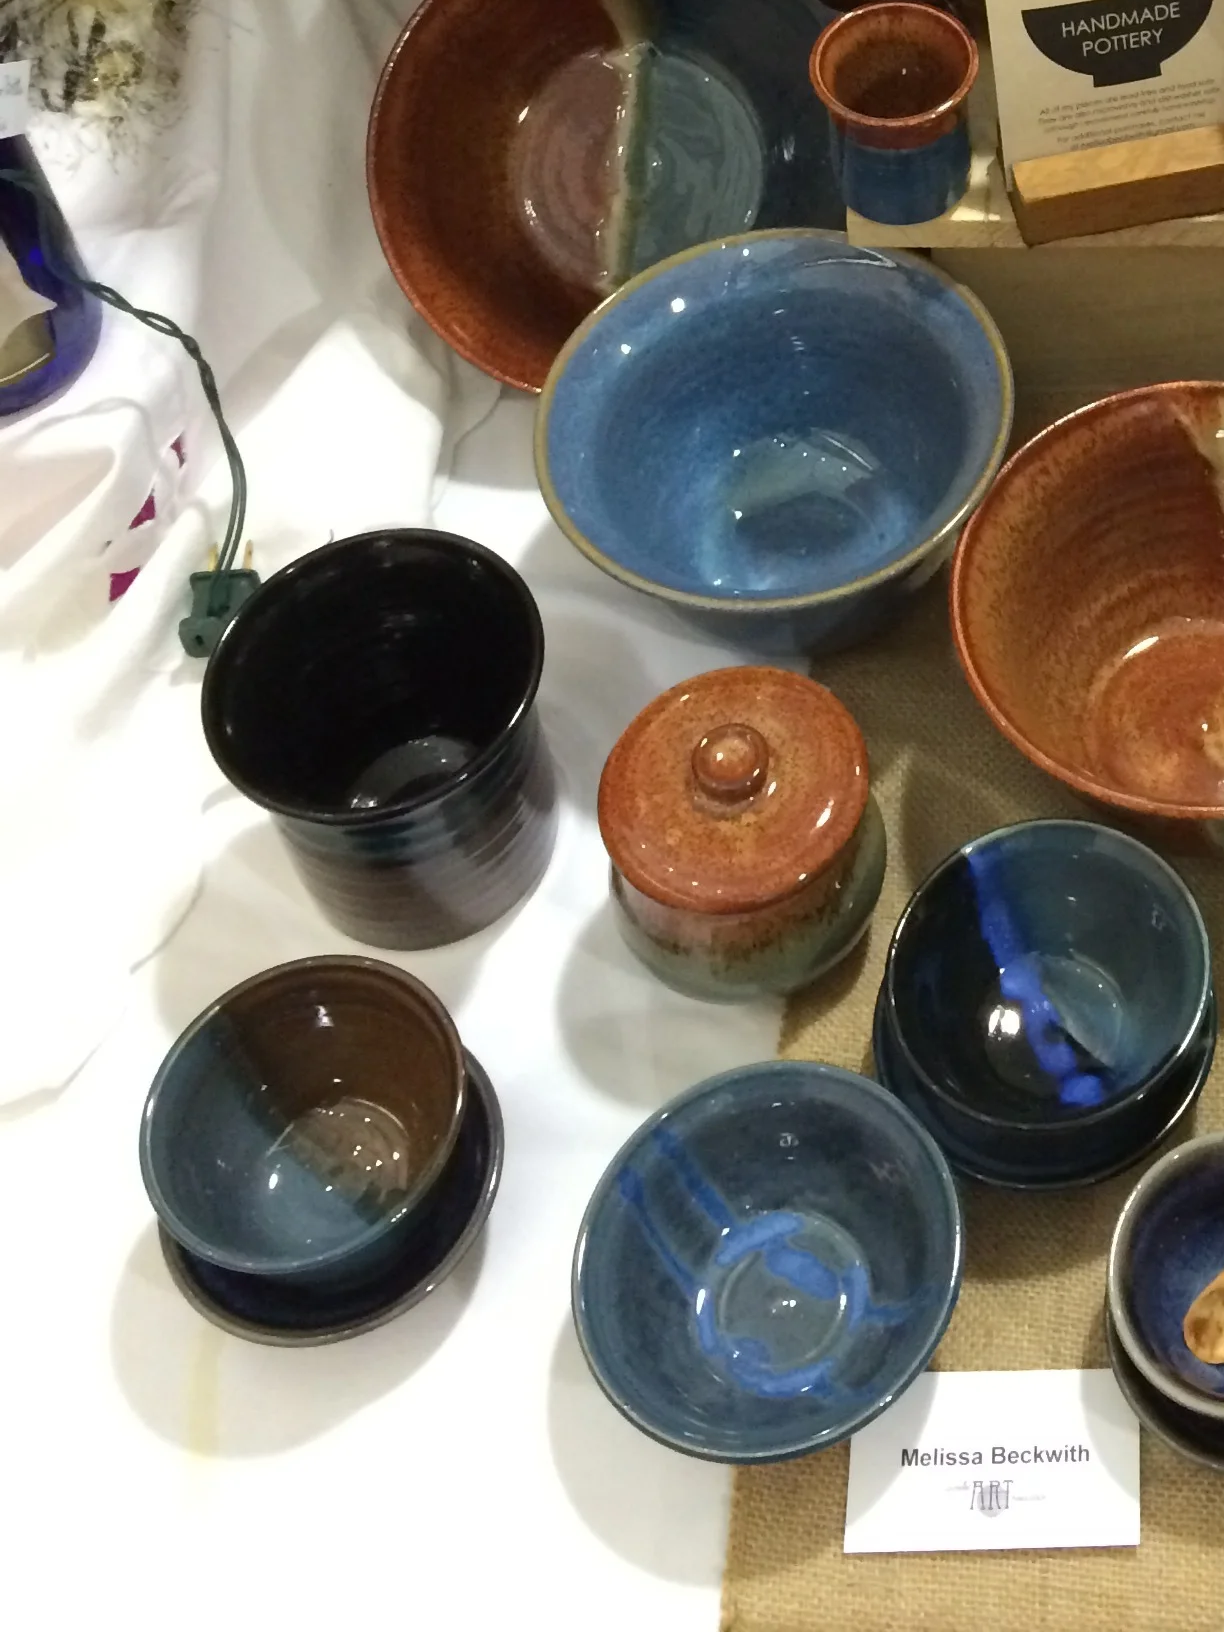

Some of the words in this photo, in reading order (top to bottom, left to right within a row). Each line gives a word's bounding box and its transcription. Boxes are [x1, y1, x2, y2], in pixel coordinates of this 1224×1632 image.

[1061, 1, 1181, 38] HANDMADE
[1082, 28, 1164, 57] POTTERY
[901, 1448, 982, 1466] Melissa
[992, 1445, 1090, 1464] Beckwith
[970, 1480, 1013, 1510] ART
